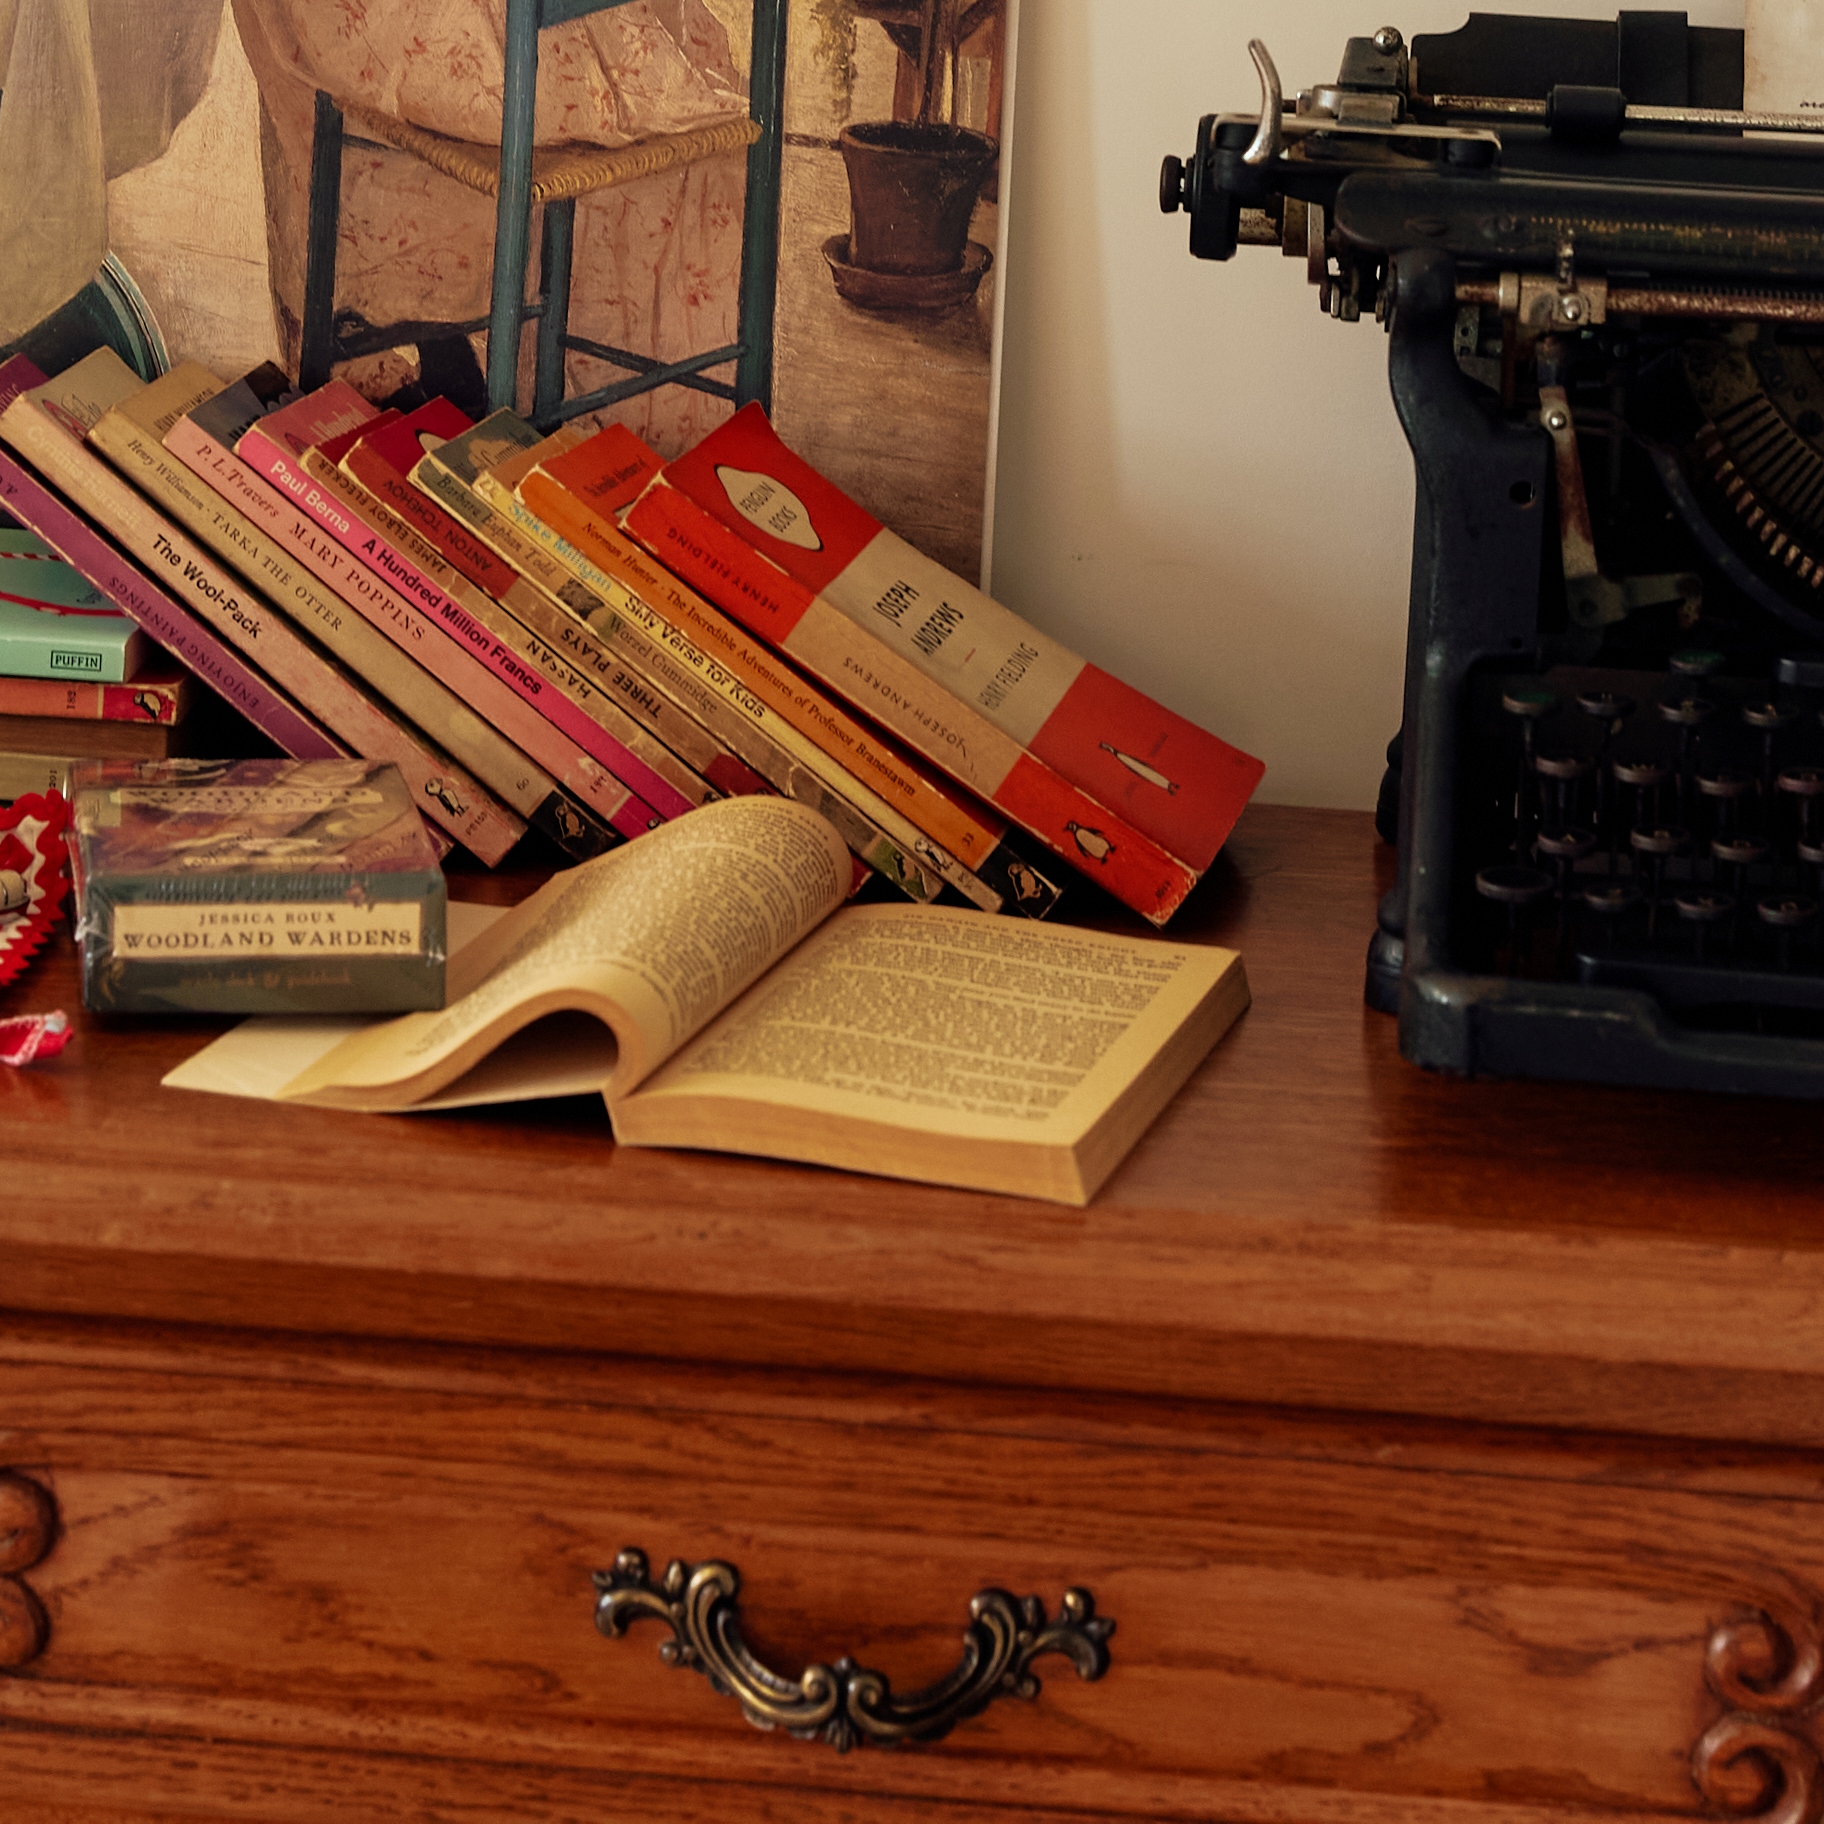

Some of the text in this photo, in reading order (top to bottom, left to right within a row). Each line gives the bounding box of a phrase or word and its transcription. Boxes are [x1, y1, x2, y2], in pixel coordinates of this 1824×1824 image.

[27, 435, 263, 639] Cynthia Harnett The Wool-Pack
[127, 439, 154, 466] Henry
[155, 460, 205, 501] Williamson
[212, 513, 259, 560] TARKA
[261, 557, 291, 586] THE
[294, 586, 342, 632] OTTER
[195, 444, 427, 643] P. L. Travers MARY POPPINS
[270, 459, 544, 697] Paul Berna A Hundred Million Francs
[315, 455, 592, 700] JAMES ELROY FLECKER HASSAN
[738, 480, 777, 516] PENGUIN
[768, 505, 798, 533] BOOKS
[55, 654, 99, 669] PUFFIN
[107, 576, 260, 709] ENJOYING PAINTINGS
[383, 479, 663, 721] ANTON TCHEHOV THREE PLAYS
[480, 509, 523, 556] Euphan
[525, 547, 558, 579] Todd
[609, 613, 649, 656] Worzel
[650, 651, 719, 714] Gummidge
[508, 501, 766, 719] Spike Milligan Silly Verse for Kids
[580, 521, 623, 558] Norman
[623, 553, 659, 587] Hunter
[666, 589, 688, 612] The
[687, 605, 736, 652] Incredible
[736, 647, 794, 699] Adventures
[794, 691, 809, 709] of
[808, 703, 854, 747] Professor
[855, 742, 917, 798] Branestawm
[666, 526, 968, 760] HENRY FIELDING JOSEPH ANDREWS
[872, 579, 920, 629] JOSEPH
[910, 601, 965, 658] ANDREWS
[976, 641, 1040, 713] HENRY FIELDING
[123, 929, 413, 951] WOODLAND WARDENS
[199, 911, 337, 928] JESSICA ROUX
